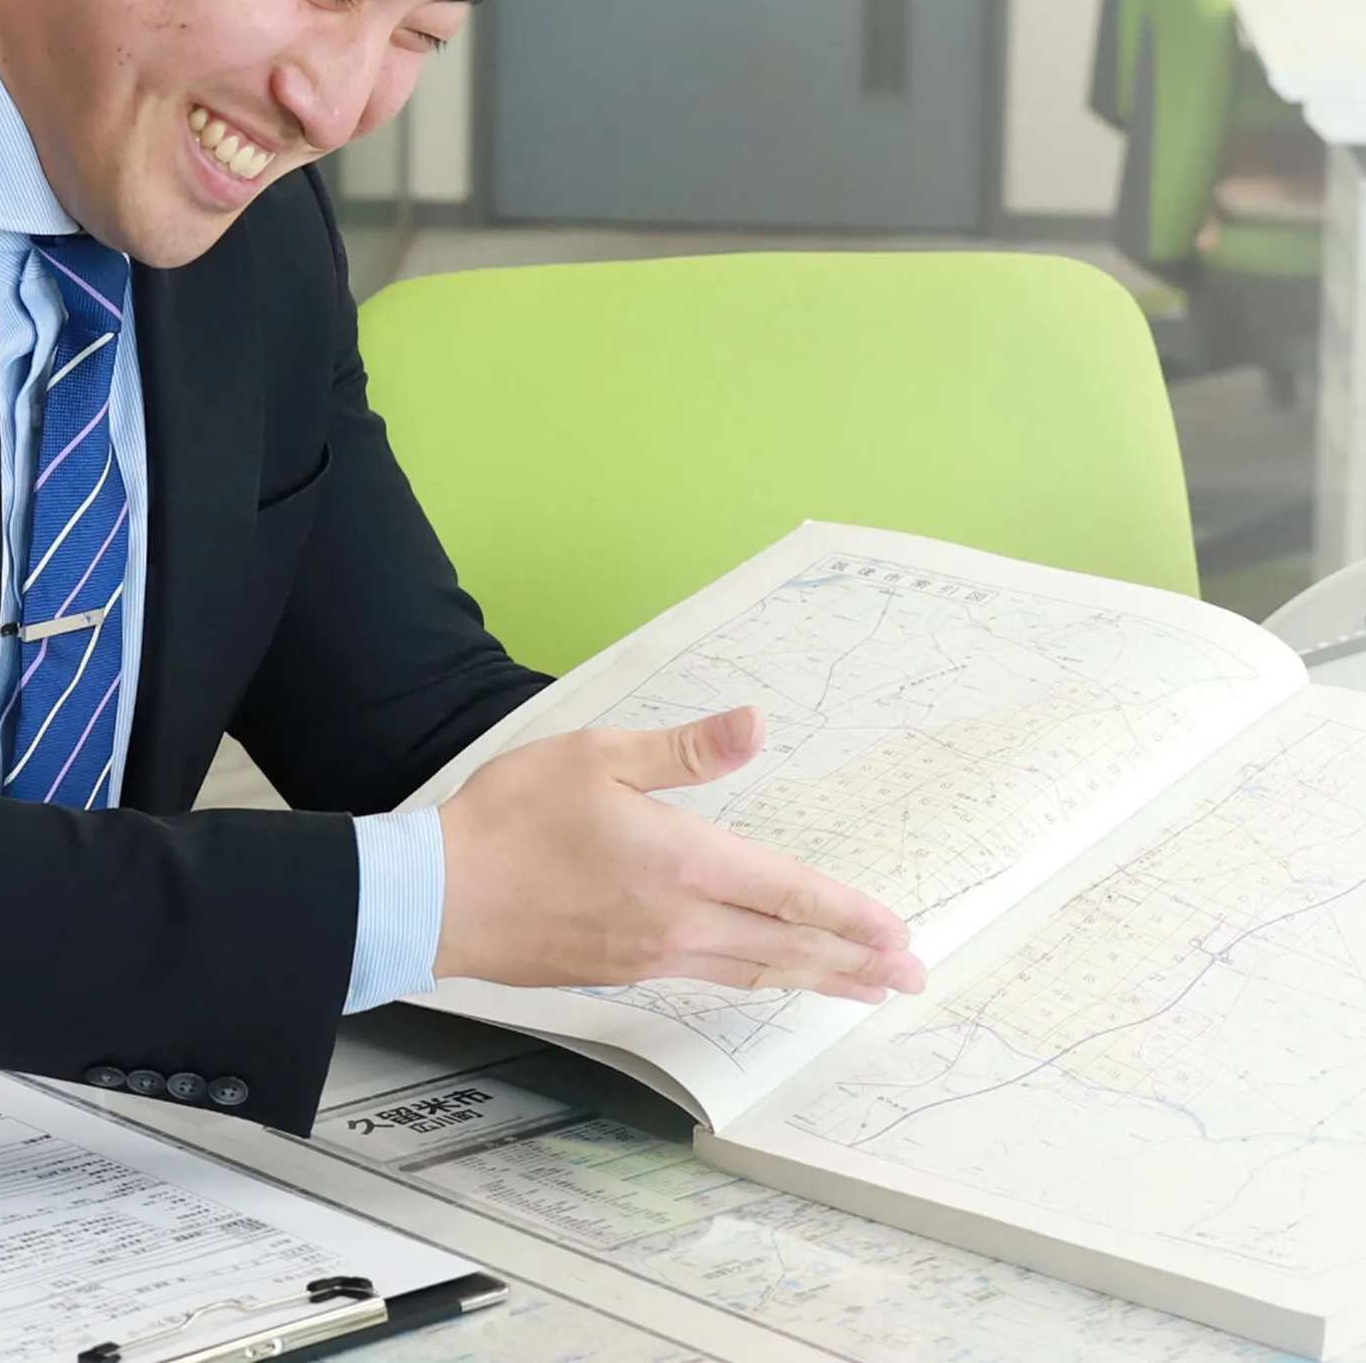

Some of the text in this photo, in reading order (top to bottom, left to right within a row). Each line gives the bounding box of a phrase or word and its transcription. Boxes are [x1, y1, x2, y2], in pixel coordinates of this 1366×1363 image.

[347, 1087, 494, 1135] 久留米市
[408, 1108, 484, 1134] 広川町
